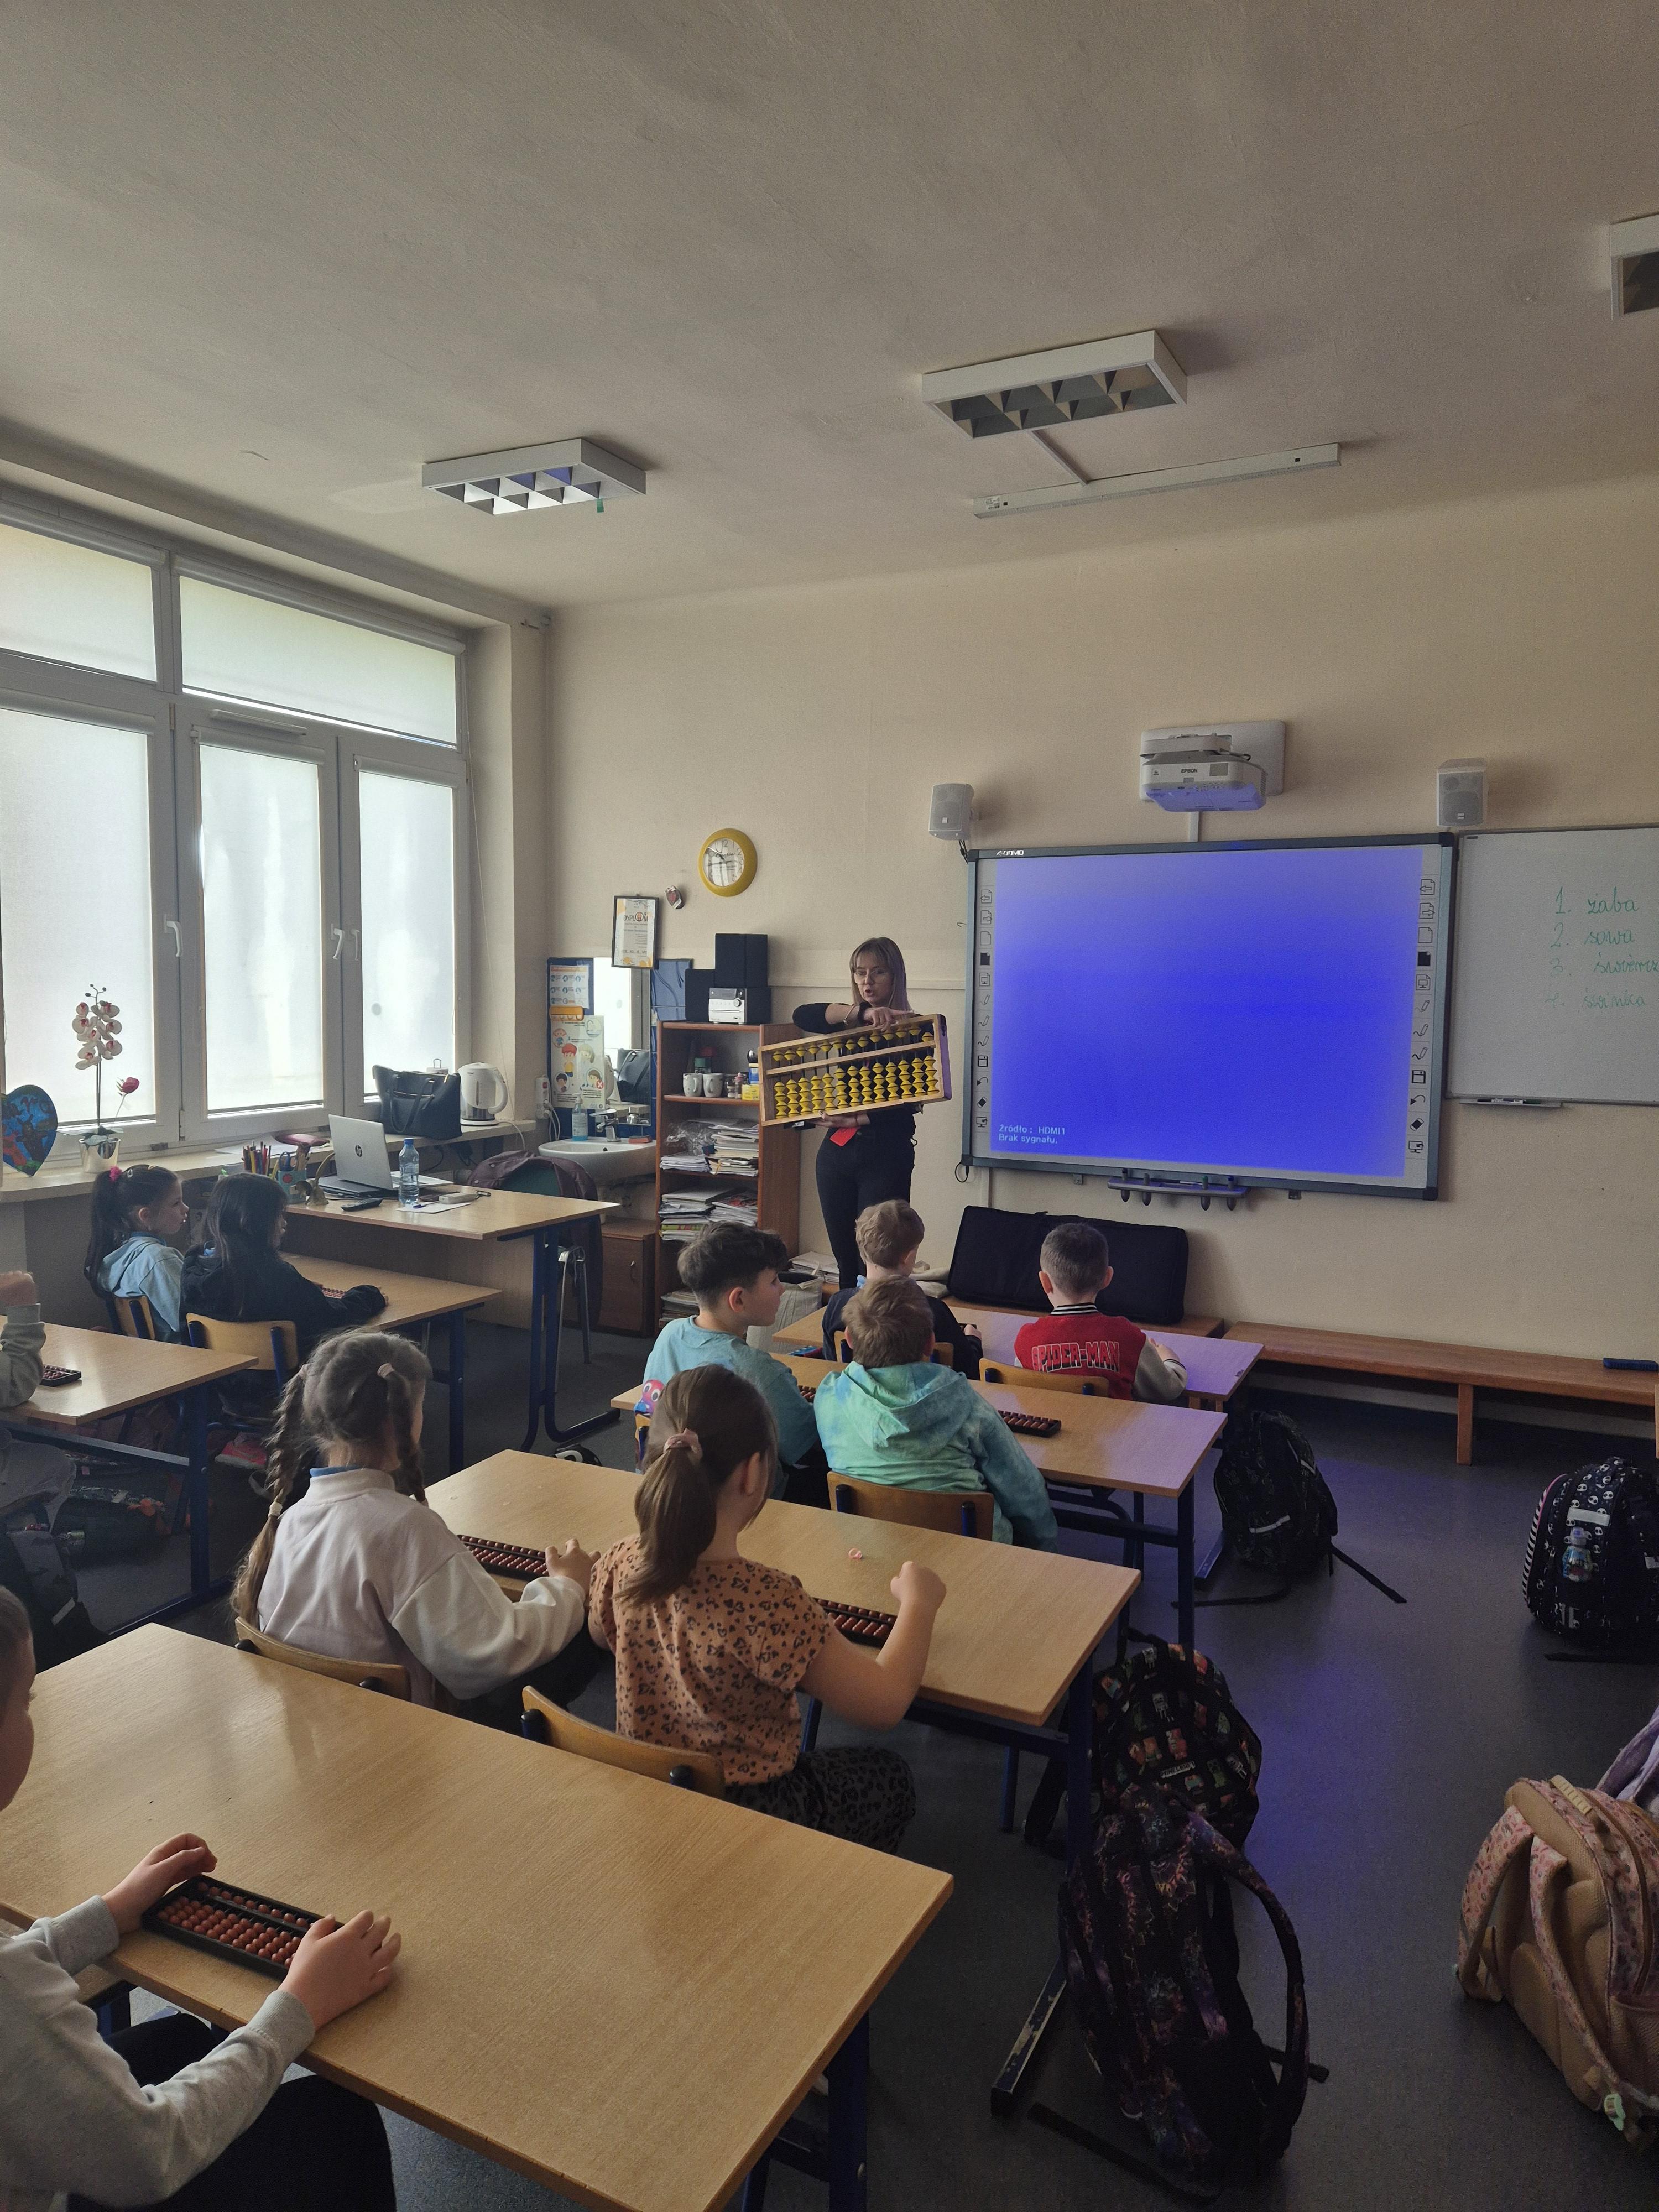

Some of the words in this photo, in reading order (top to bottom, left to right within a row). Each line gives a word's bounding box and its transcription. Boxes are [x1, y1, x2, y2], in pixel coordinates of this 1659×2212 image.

[1556, 886, 1572, 914] 1.
[1588, 886, 1640, 914] żaba
[1551, 922, 1569, 947] 2.
[1584, 930, 1635, 945] sowa
[999, 1133, 1018, 1141] Brak
[1038, 1126, 1065, 1135] HDMI1
[1032, 1341, 1120, 1373] SPIDER-MAN
